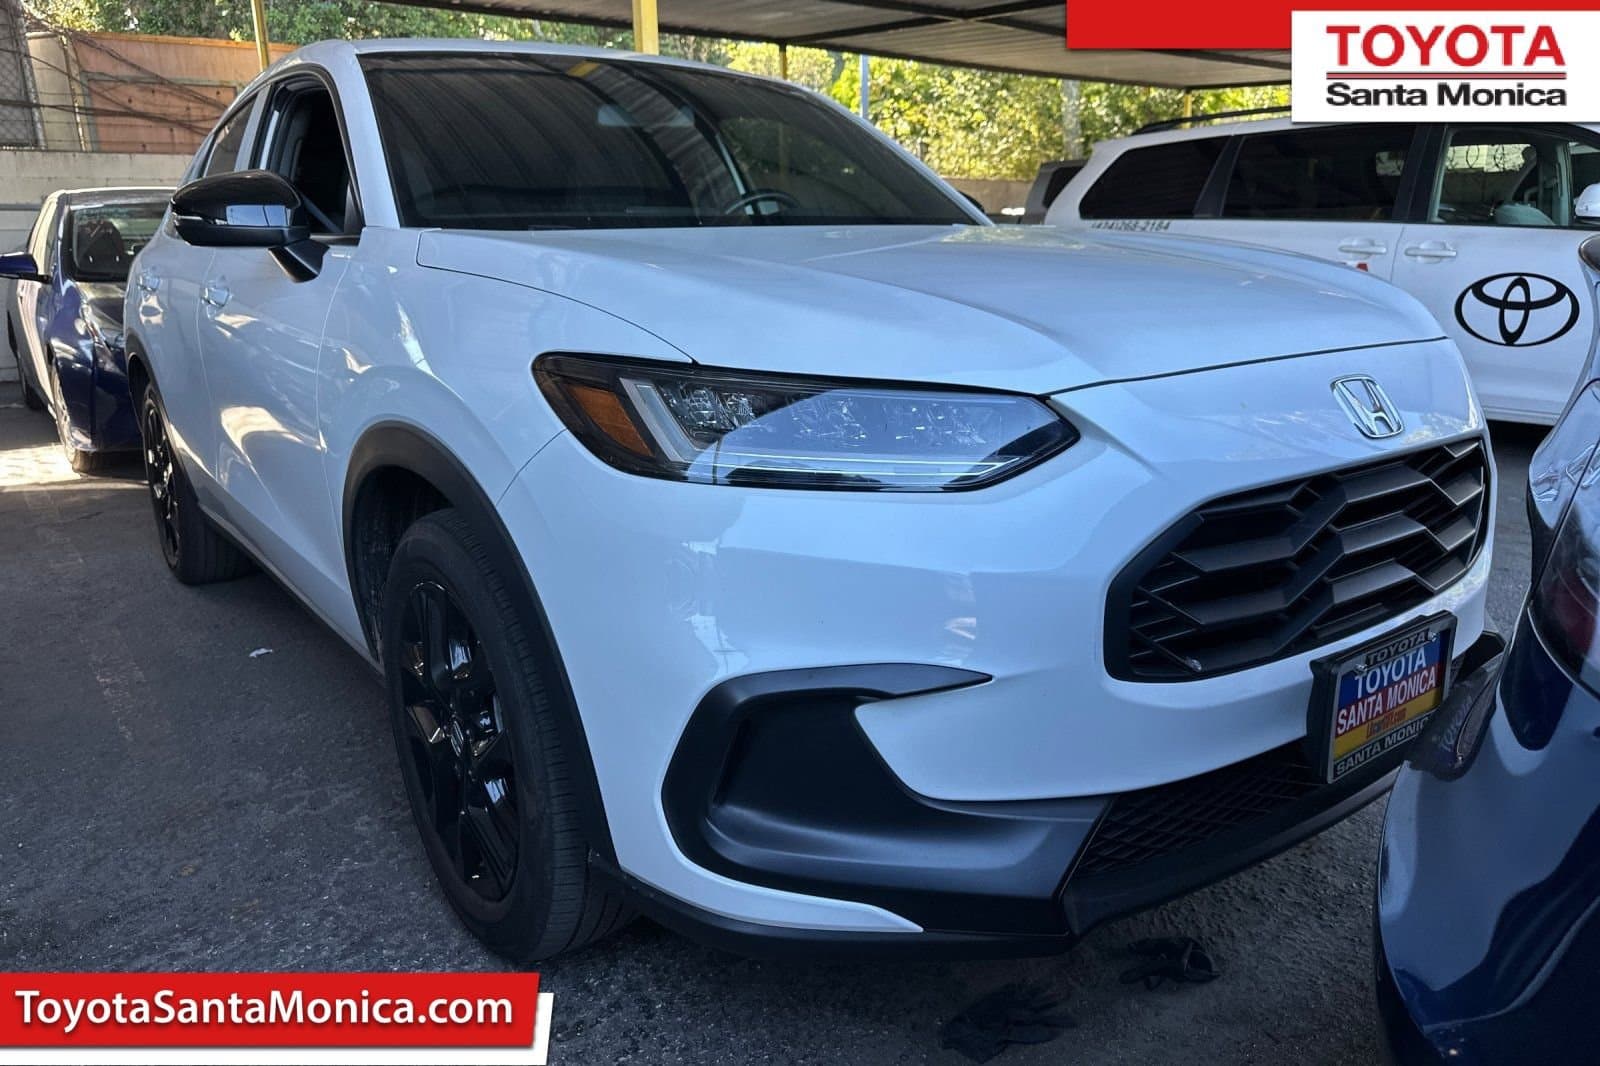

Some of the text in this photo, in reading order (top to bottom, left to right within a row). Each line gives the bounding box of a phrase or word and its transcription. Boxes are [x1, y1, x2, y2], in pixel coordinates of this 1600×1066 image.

[1354, 646, 1427, 699] TOYOTA
[1367, 631, 1427, 665] TOYOTA
[1336, 692, 1384, 735] SANTA
[1386, 667, 1437, 712] MONICA
[1336, 742, 1382, 775] SANTA
[1384, 717, 1430, 749] MONIC
